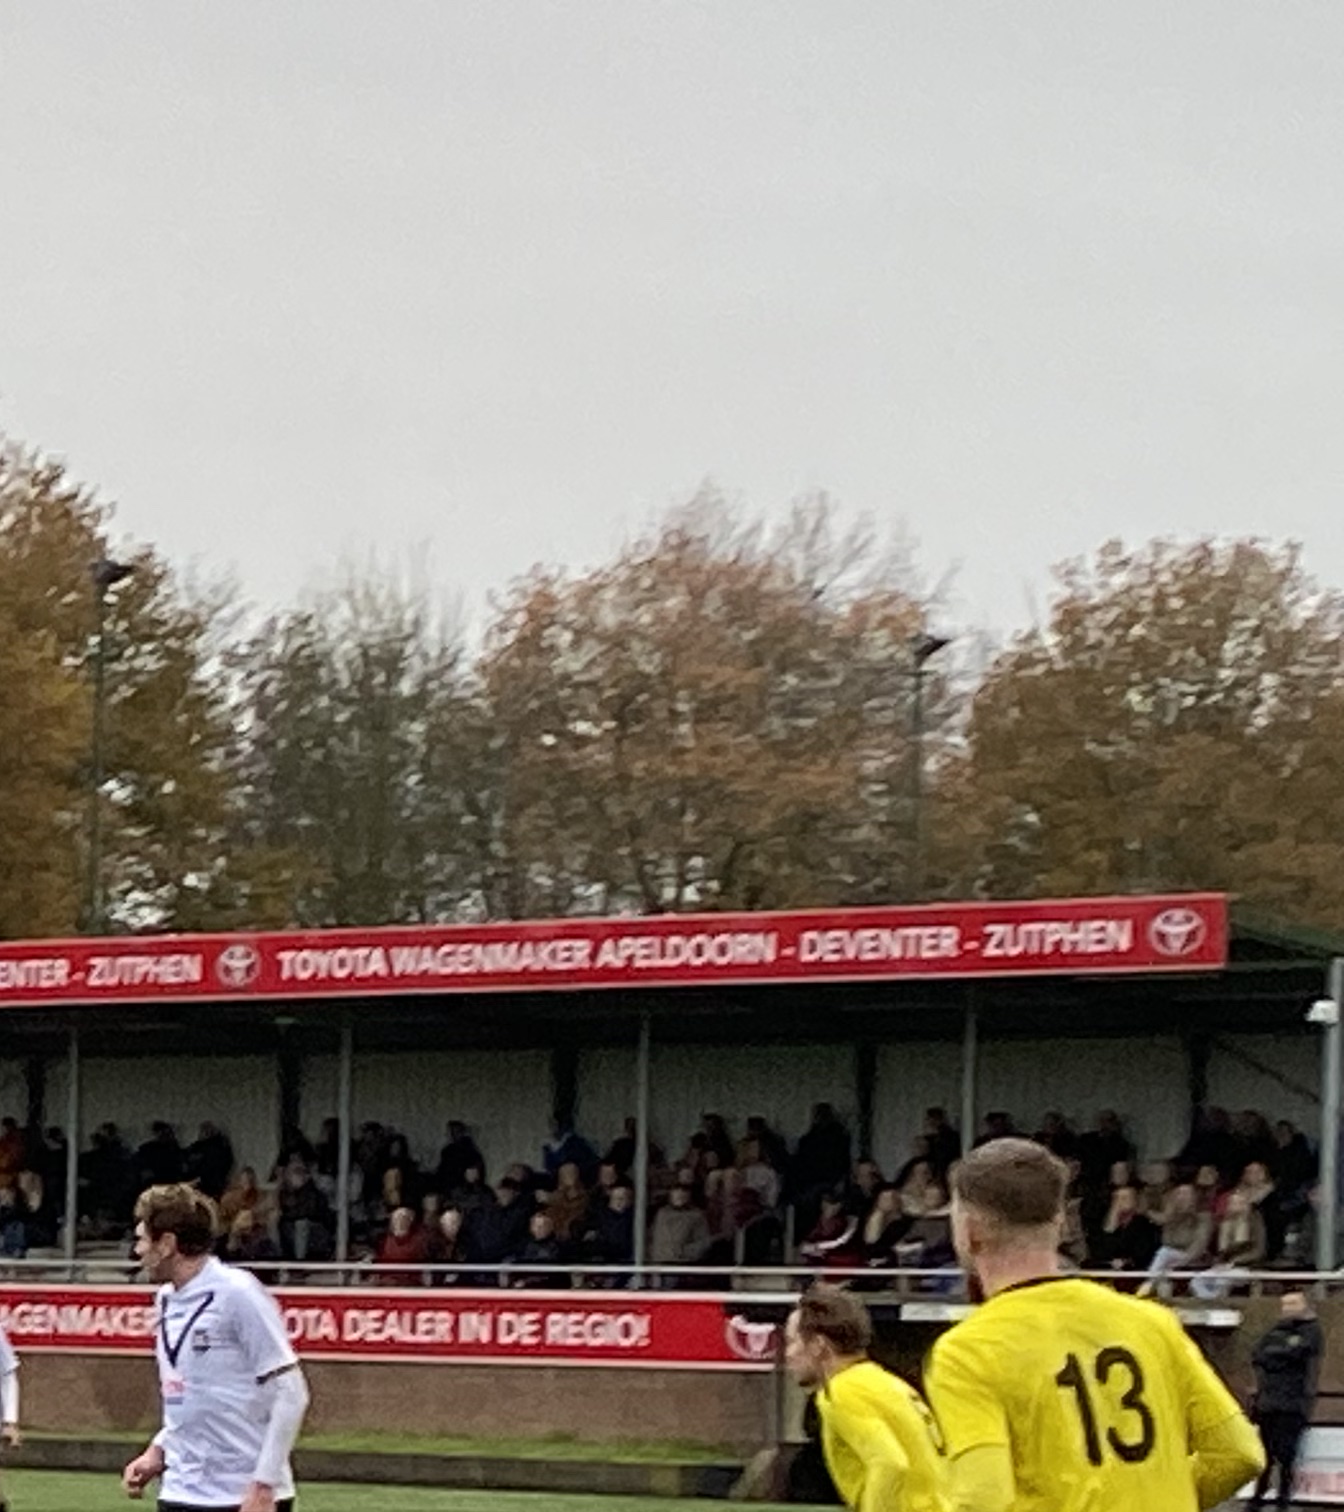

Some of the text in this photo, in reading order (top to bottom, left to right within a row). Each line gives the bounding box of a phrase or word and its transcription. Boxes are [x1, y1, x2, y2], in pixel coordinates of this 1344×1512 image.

[86, 953, 202, 987] ZUTPHEN
[277, 946, 388, 981] TOYOTA
[389, 939, 592, 977] WAGENMAKER
[594, 931, 777, 969] APELDOORN
[799, 925, 959, 963] DEVENTER
[983, 919, 1132, 958] ZUTPHEN
[343, 1308, 452, 1345] DEALER
[457, 1311, 493, 1345] IN
[497, 1311, 543, 1346] DE
[546, 1312, 651, 1348] REGIO!
[1055, 1345, 1155, 1467] 13
